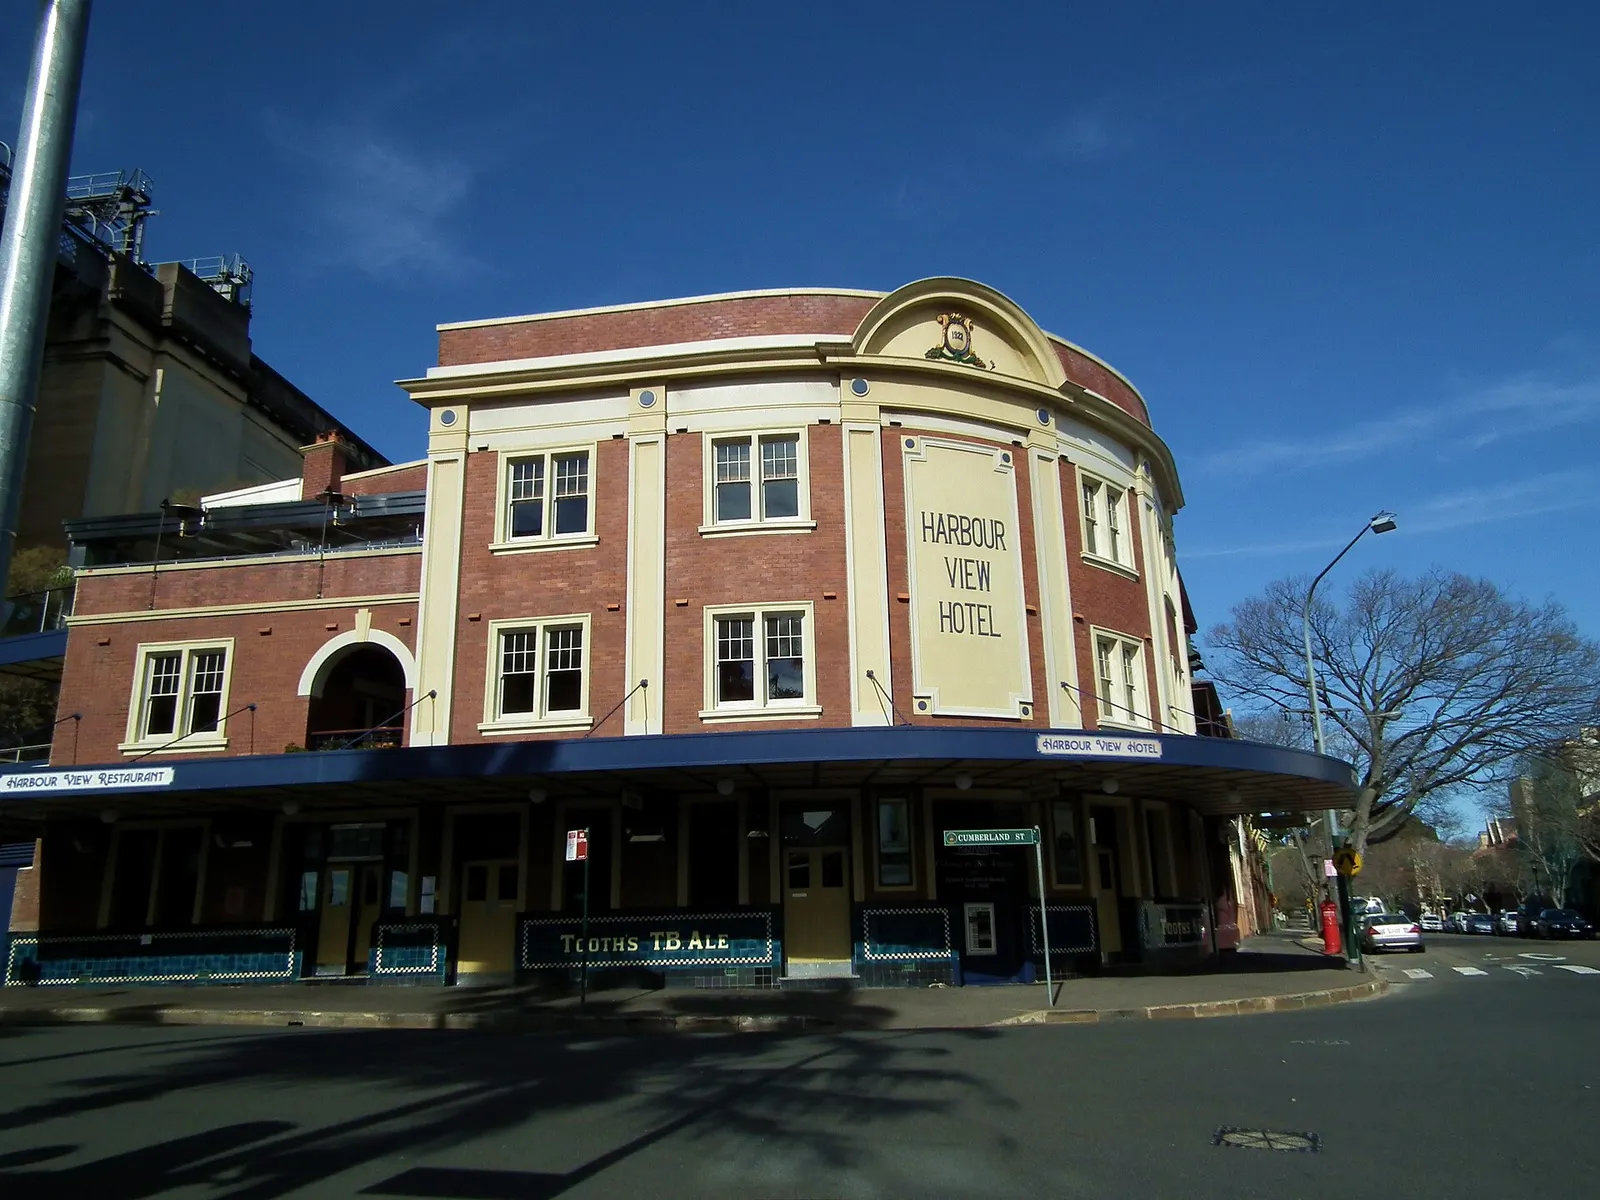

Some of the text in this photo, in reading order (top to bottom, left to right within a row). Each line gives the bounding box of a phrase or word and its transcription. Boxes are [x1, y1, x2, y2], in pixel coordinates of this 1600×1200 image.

[921, 511, 1007, 551] HARBOUR
[944, 556, 991, 592] VIEW
[939, 601, 1002, 637] HOTEL
[1042, 738, 1158, 754] HARBOUR VIEW HOTEL
[6, 771, 165, 789] HARBOUR VIEW RESTAURANT
[957, 833, 1025, 842] CUMBERLAND ST
[687, 929, 730, 951] ALE
